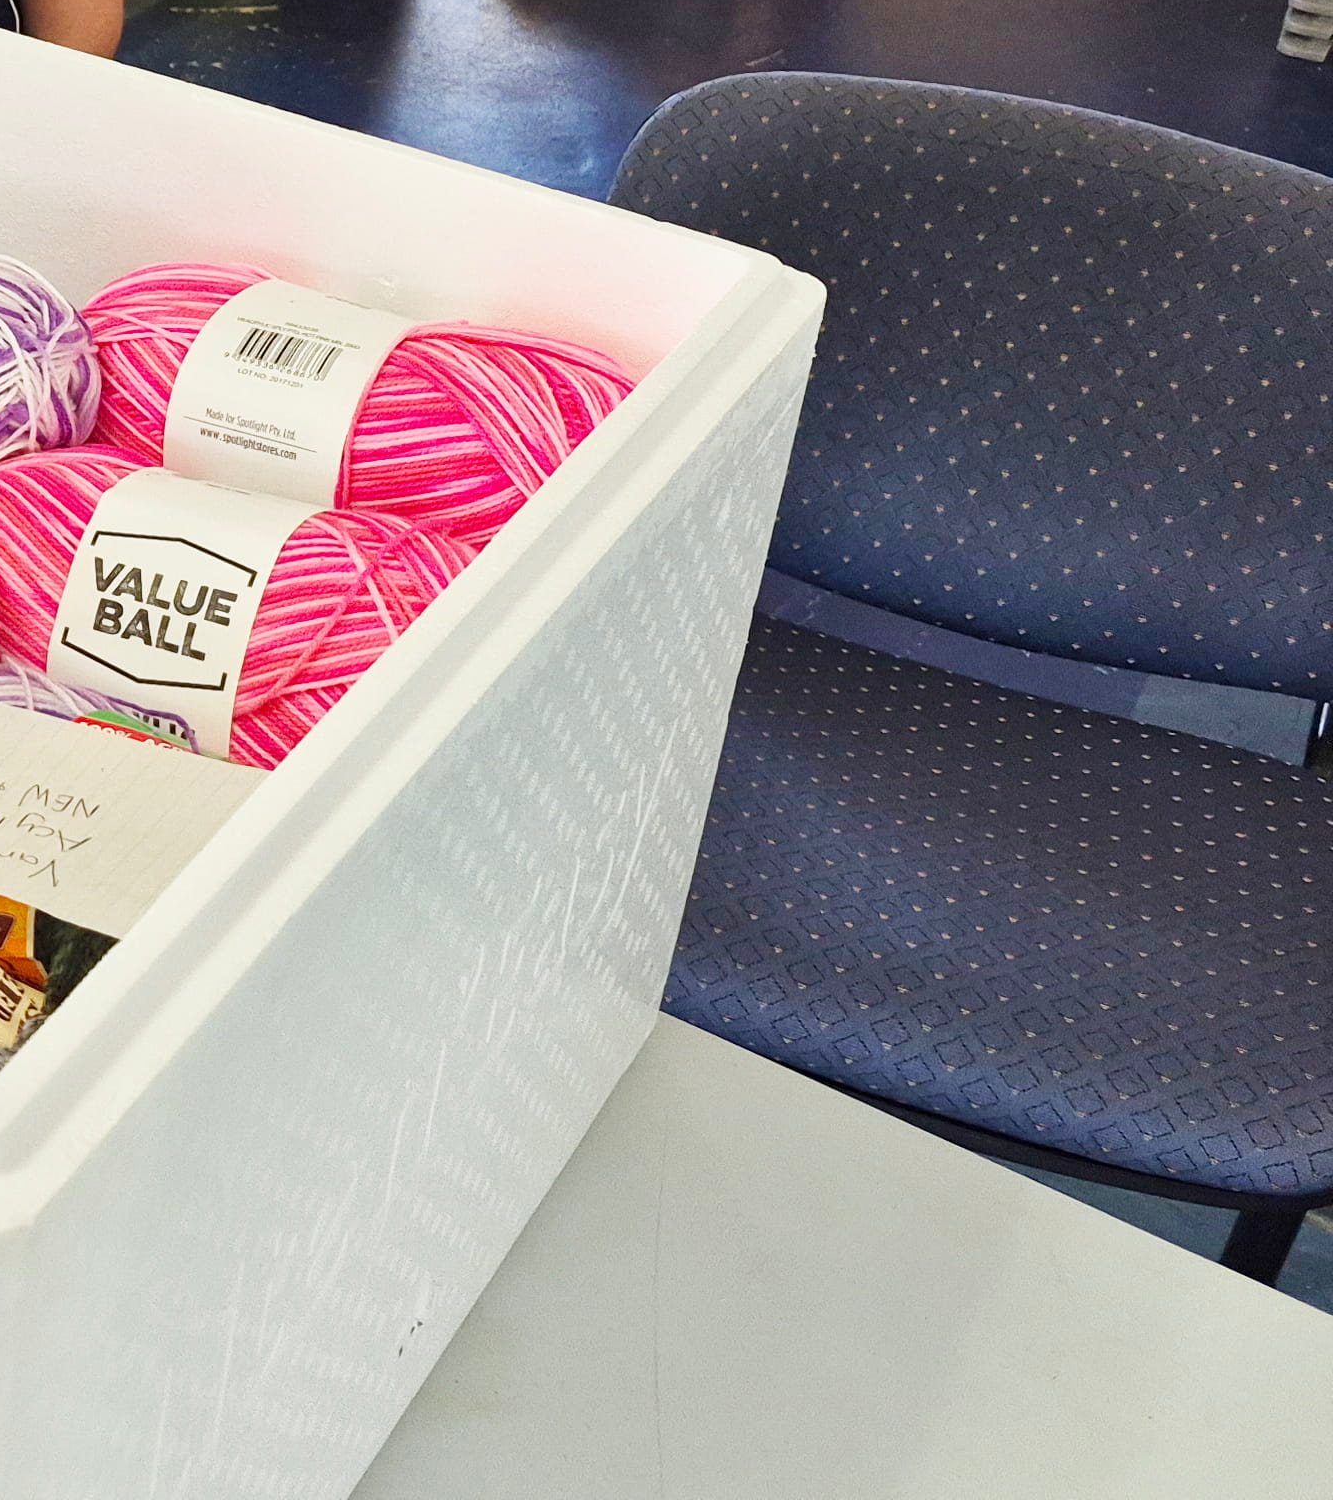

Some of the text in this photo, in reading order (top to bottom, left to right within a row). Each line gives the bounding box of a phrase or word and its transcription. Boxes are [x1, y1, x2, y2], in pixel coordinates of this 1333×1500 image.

[205, 406, 226, 422] Made
[226, 412, 236, 425] for
[236, 415, 269, 434] Spotlight
[199, 426, 298, 461] www.spotlightstores.com
[91, 555, 239, 630] VALUE
[91, 600, 209, 664] BALL
[17, 783, 101, 819] NEW
